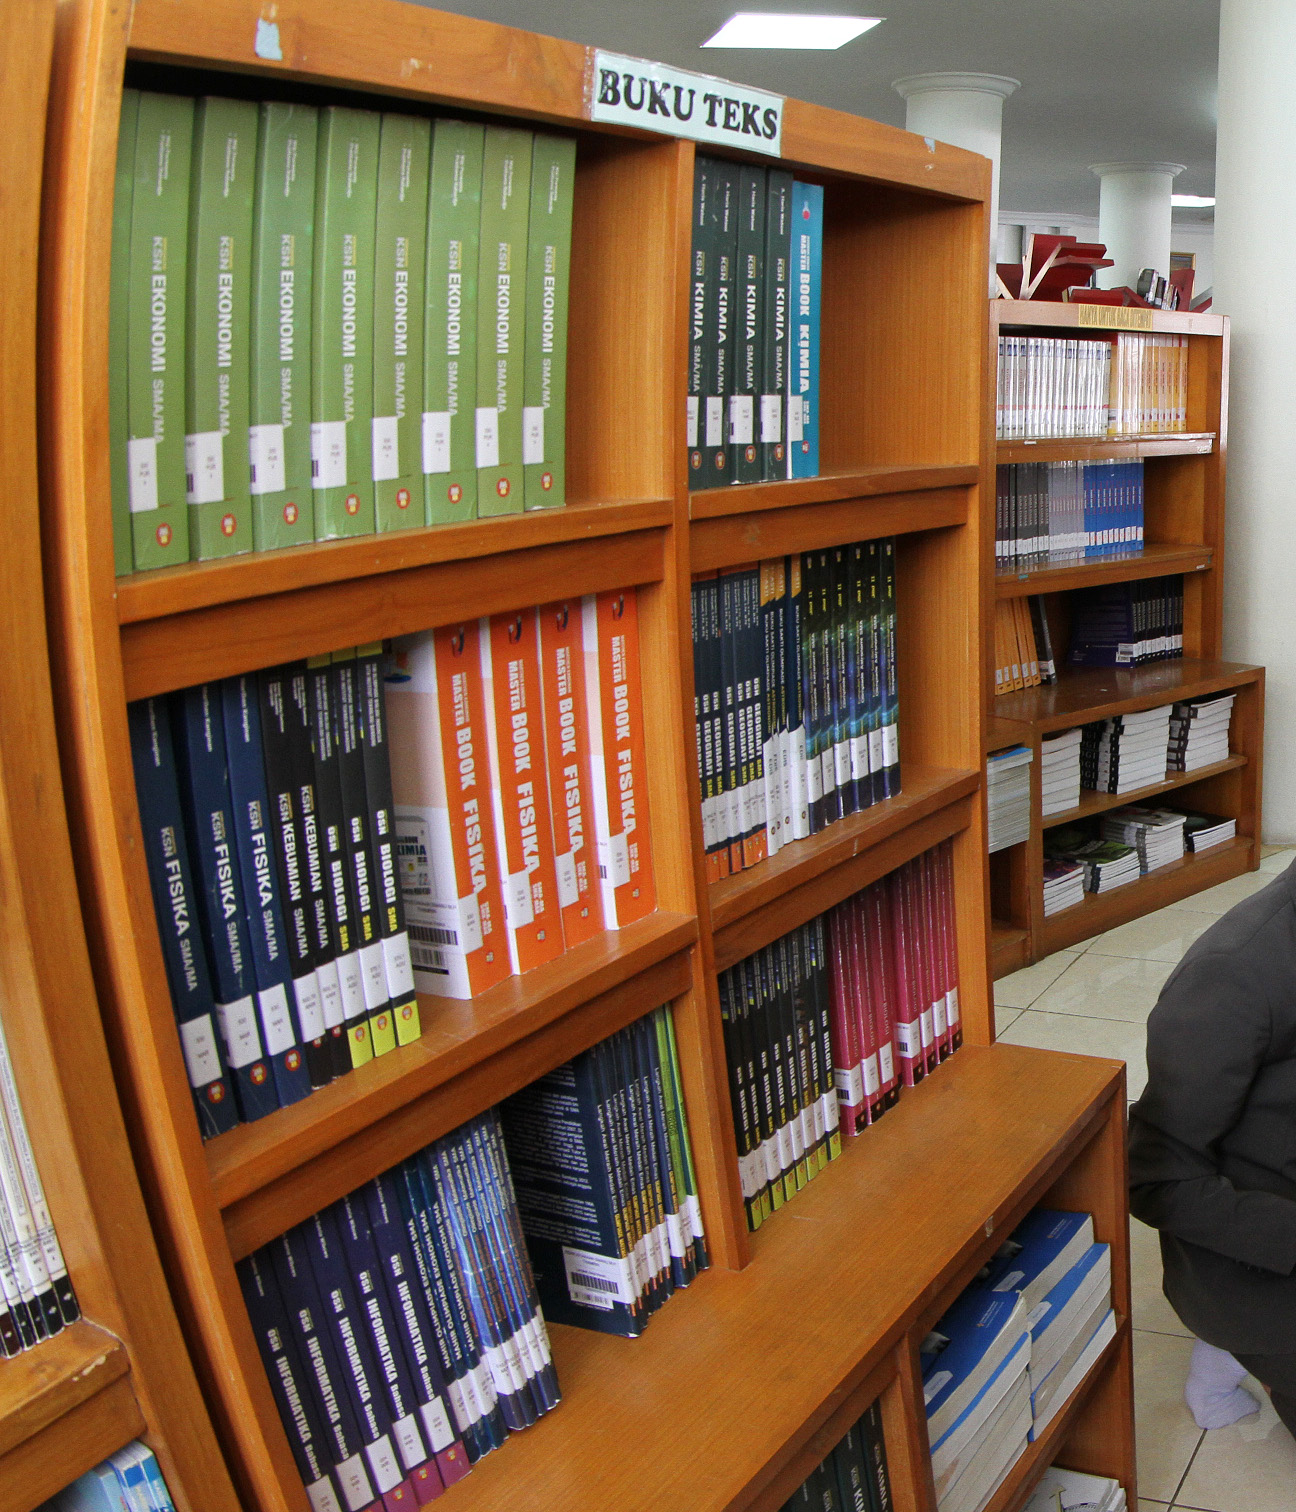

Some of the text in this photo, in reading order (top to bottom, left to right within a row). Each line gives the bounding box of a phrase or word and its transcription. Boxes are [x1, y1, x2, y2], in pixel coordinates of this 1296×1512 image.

[598, 68, 779, 140] BUKU TEKS
[280, 234, 294, 361] KSN EKONOMI
[342, 234, 356, 358] KSN EKONOMI
[396, 237, 405, 268] KSN
[449, 240, 458, 270] KSN
[498, 242, 507, 271] KSN
[544, 246, 554, 273] KSN
[720, 256, 728, 281] KSN
[800, 272, 810, 316] BOOK
[152, 236, 166, 372] KSN EKONOMI
[218, 236, 233, 368] KSN EKONOMI
[394, 270, 408, 356] EKONOMI
[447, 273, 461, 356] EKONOMI
[496, 274, 510, 354] EKONOMI
[542, 276, 554, 352] EKONOMI
[694, 282, 704, 340] KIMIA
[718, 287, 728, 344] KIMIA
[746, 285, 756, 340] KIMIA
[776, 288, 784, 341] KIMIA
[746, 345, 754, 389] SMA/MA
[800, 324, 810, 393] KIMIA
[452, 674, 464, 726] MASTER
[508, 660, 520, 711] MASTER
[456, 726, 476, 790] BOOK
[512, 712, 531, 774] BOOK
[556, 648, 584, 856] MASTER BOOK FISIKA
[612, 636, 636, 835] MASTER BOOK FISIKA
[728, 712, 736, 768] GEOGRAFI
[300, 785, 328, 948] KSN KEBUMIAN SMA/MA
[376, 809, 398, 932] OSN BIOLOGI SMA
[463, 798, 487, 894] FISIKA
[517, 781, 540, 874] FISIKA
[161, 826, 198, 992] KSN FISIKA SMA/MA
[211, 811, 243, 974] KSN FISIKA SMA/MA
[248, 801, 279, 962] KSN FISIKA SMA/MA
[278, 793, 308, 958] KSN KEBUMIAN SMA/MA
[327, 826, 349, 952] OSN BIOLOGI SMA
[351, 817, 372, 940] OSN BIOLOGI SMA
[776, 1064, 785, 1106] BIOLOGI
[390, 1254, 403, 1277] OSN
[398, 1280, 428, 1365] INFORMATIKA
[408, 1218, 452, 1370] MAHIR OLIMPIADE EKONOMI SMA
[420, 1210, 462, 1361] MAHIR OLIMPIADE EKONOMI SMA
[434, 1201, 476, 1352] MAHIR OLIMPIADE EKONOMI SMA
[299, 1309, 312, 1332] OSN
[307, 1336, 341, 1424] INFORMATIKA
[330, 1290, 343, 1314] OSN
[338, 1317, 371, 1403] INFORMATIKA
[360, 1271, 372, 1294] OSN
[367, 1298, 398, 1383] INFORMATIKA
[268, 1328, 280, 1352] OSN
[276, 1356, 312, 1443] INFORMATIKA
